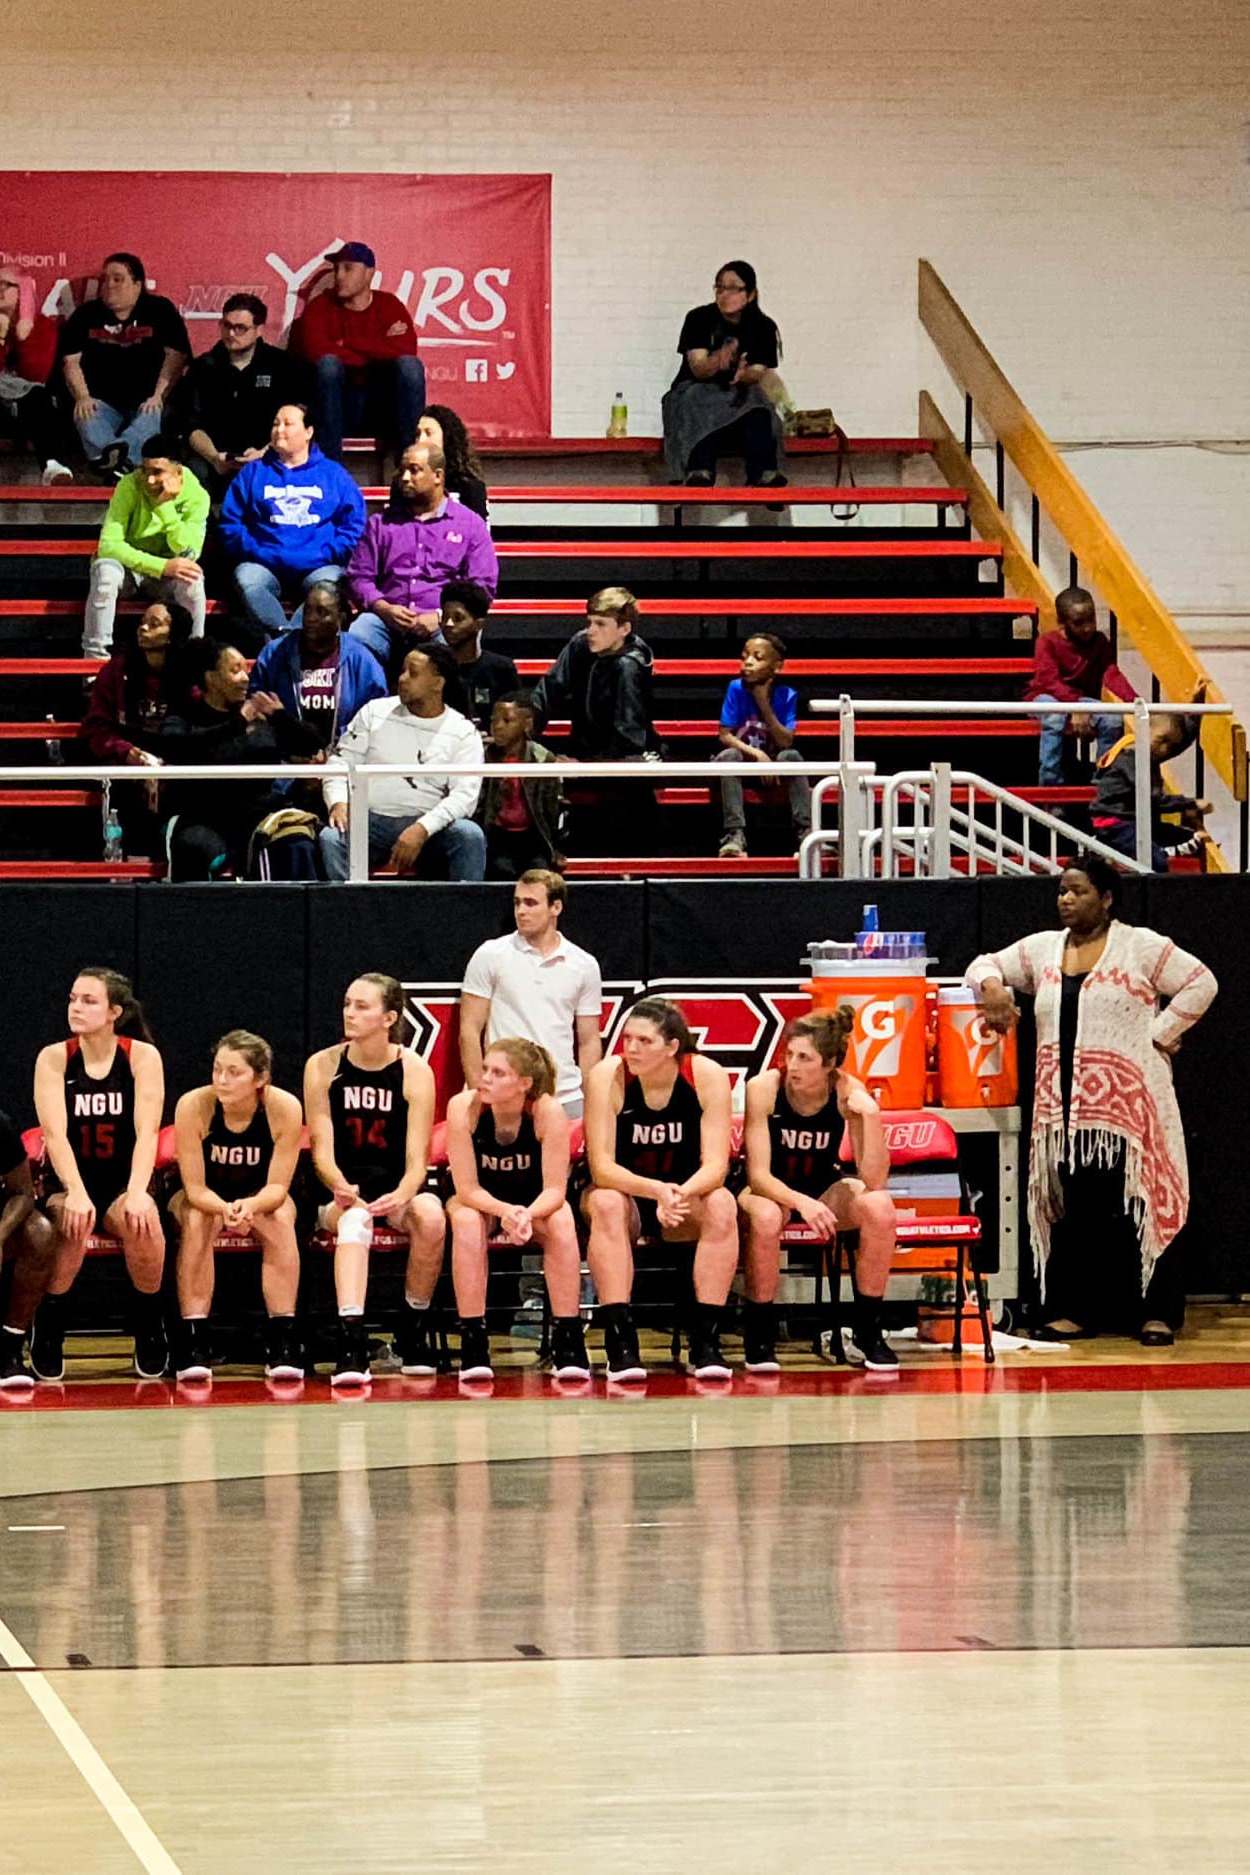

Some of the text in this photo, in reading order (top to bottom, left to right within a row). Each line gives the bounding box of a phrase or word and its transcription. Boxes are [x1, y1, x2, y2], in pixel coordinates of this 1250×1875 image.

[861, 1000, 896, 1040] G
[74, 1092, 123, 1116] NGU
[343, 1086, 393, 1112] NGU
[80, 1123, 115, 1160] 15
[632, 1122, 683, 1144] NGU
[781, 1128, 830, 1149] NGU
[210, 1143, 261, 1166] NGU
[481, 1153, 531, 1171] NGU
